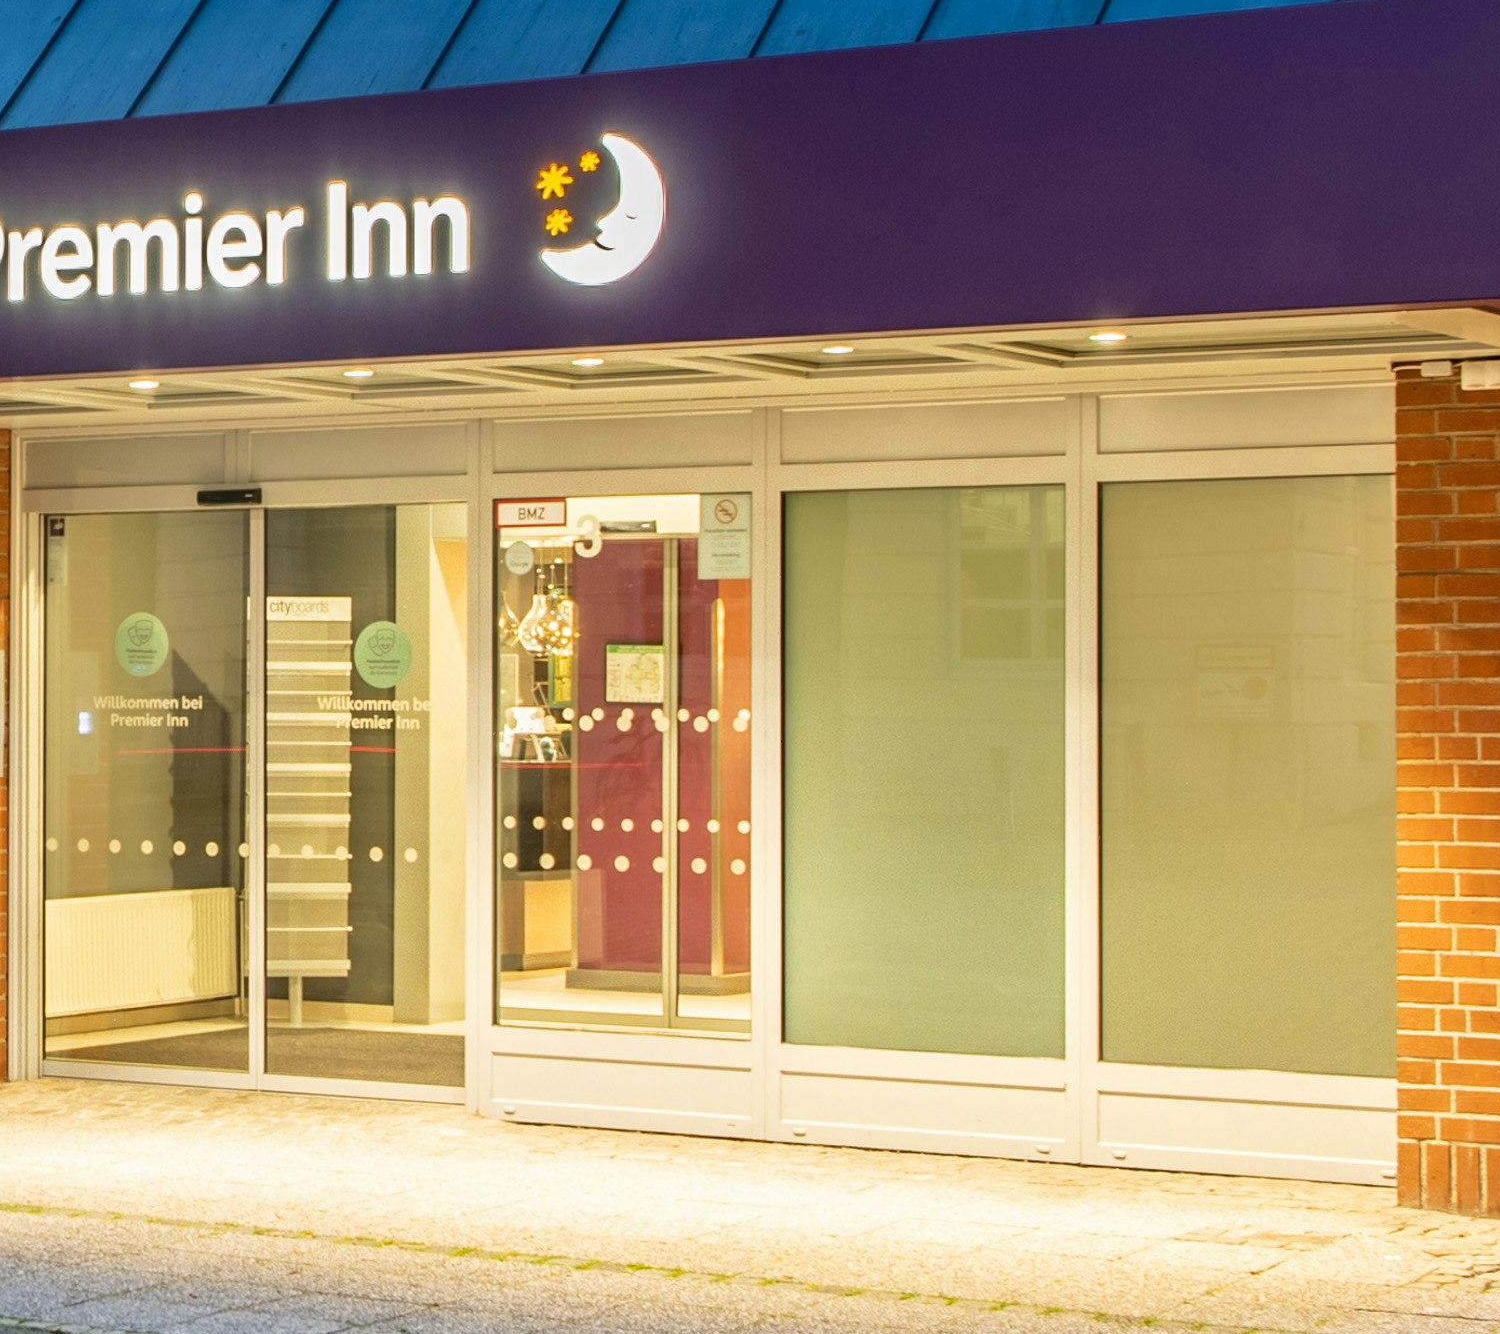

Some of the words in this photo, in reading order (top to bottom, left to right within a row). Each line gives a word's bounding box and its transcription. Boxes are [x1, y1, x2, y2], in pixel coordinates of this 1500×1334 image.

[327, 179, 471, 282] Inn
[517, 507, 546, 521] BMZ
[574, 514, 602, 559] 3
[93, 695, 179, 710] Willkommen
[181, 695, 204, 710] bei
[316, 696, 410, 712] Willkommen
[413, 697, 432, 712] be
[110, 713, 164, 727] Premier
[166, 713, 189, 727] Inn
[397, 715, 420, 730] Inn
